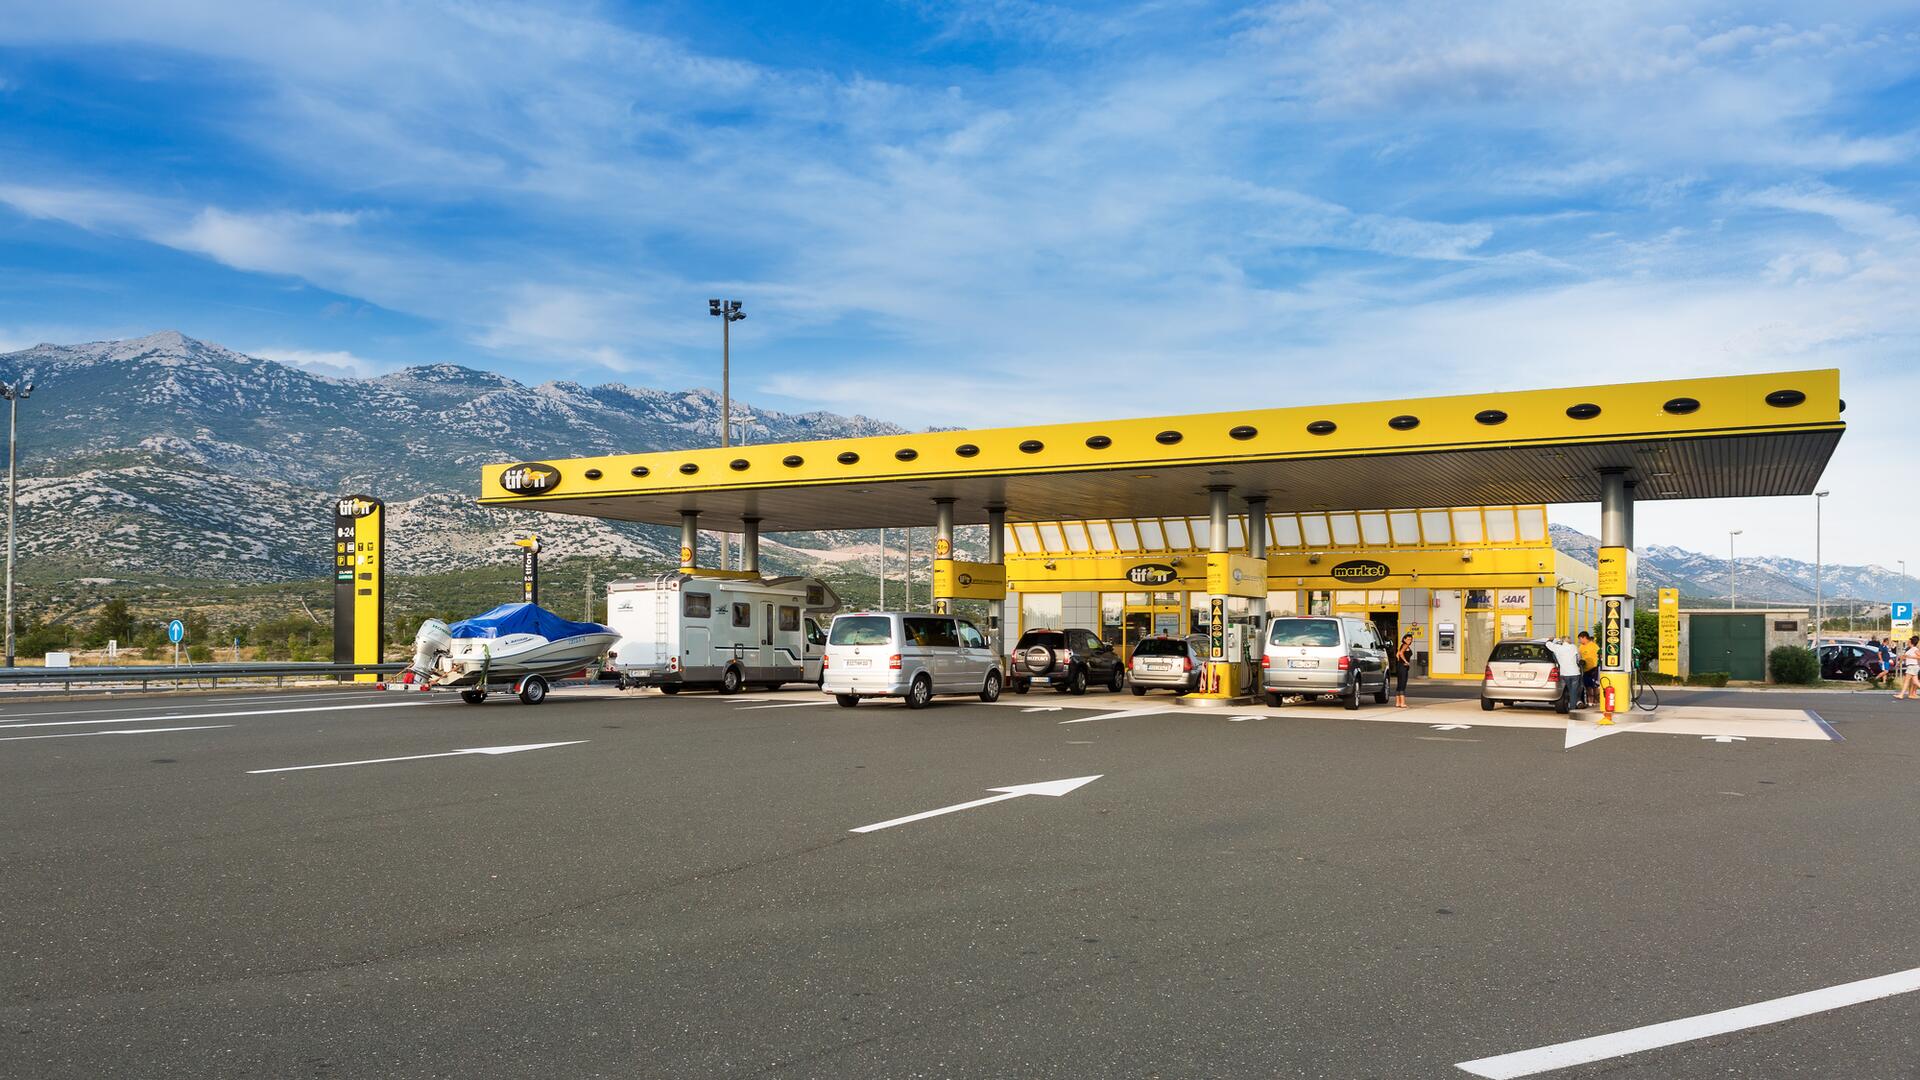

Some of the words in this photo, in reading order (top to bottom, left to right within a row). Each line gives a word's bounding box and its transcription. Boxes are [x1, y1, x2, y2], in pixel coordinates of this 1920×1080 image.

[505, 468, 545, 489] tifon
[337, 527, 355, 538] 0-24
[1334, 565, 1385, 577] market
[1501, 595, 1526, 604] HAK
[1897, 605, 1907, 617] P
[432, 623, 449, 634] HOND
